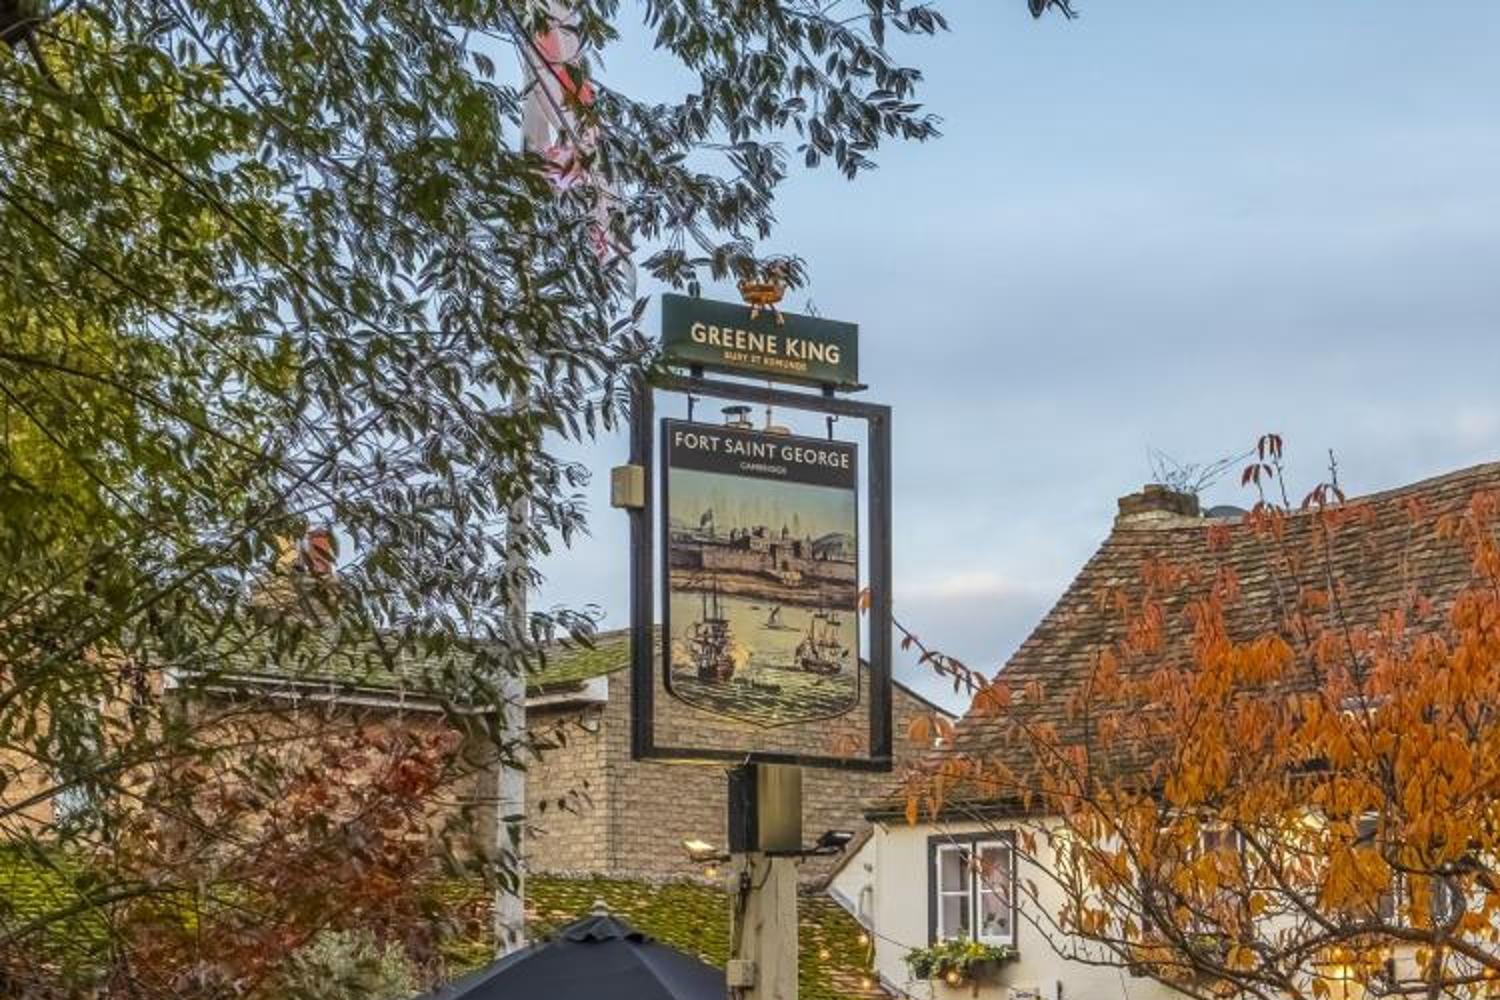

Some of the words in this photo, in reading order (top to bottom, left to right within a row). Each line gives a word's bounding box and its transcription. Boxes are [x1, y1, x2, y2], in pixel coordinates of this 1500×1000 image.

[691, 323, 777, 354] GREENE
[785, 338, 840, 364] KING
[675, 431, 720, 451] FORT
[725, 439, 776, 460] SAINT
[781, 445, 850, 469] GEORGE
